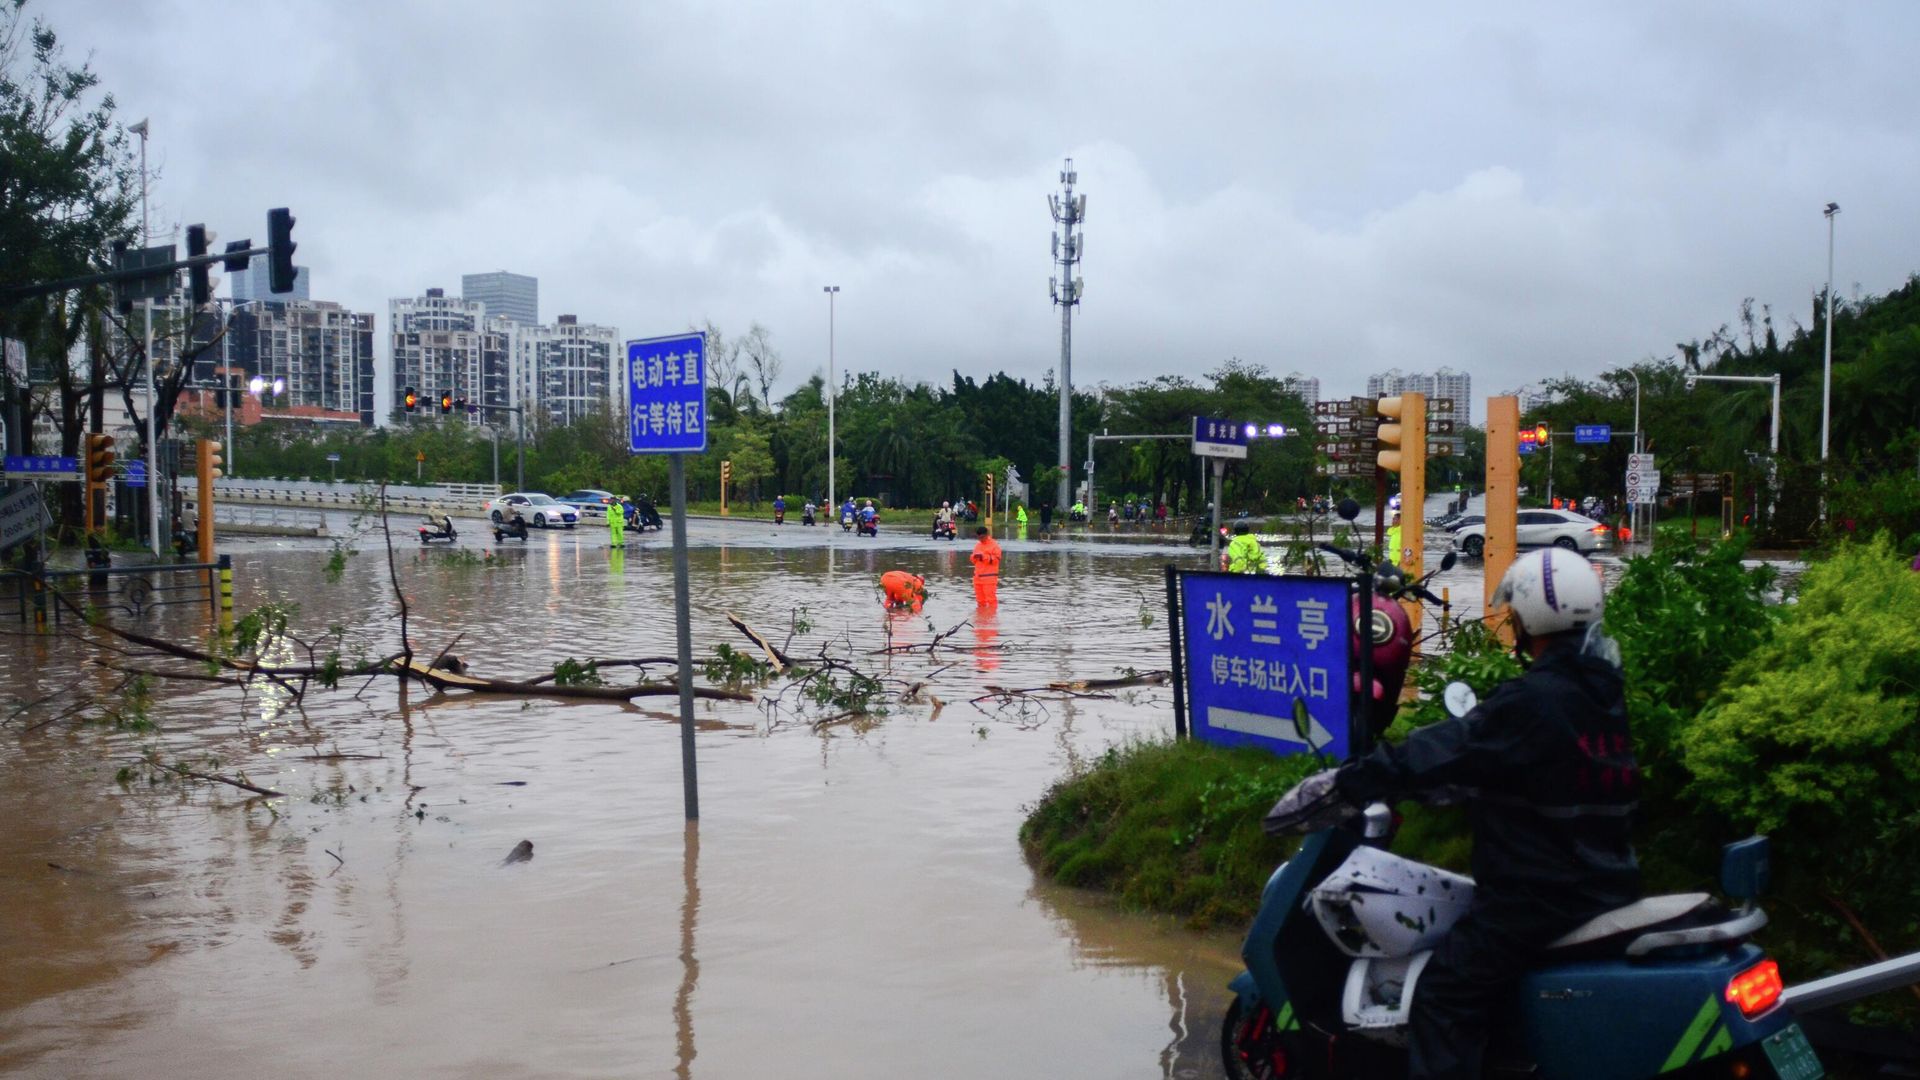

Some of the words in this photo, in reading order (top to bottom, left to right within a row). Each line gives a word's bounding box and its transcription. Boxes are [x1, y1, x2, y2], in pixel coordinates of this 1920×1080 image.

[632, 349, 700, 389] 电动车直
[633, 401, 701, 437] 行等待区
[1206, 592, 1330, 651] 水兰亭
[1211, 654, 1329, 700] 停车场出入口
